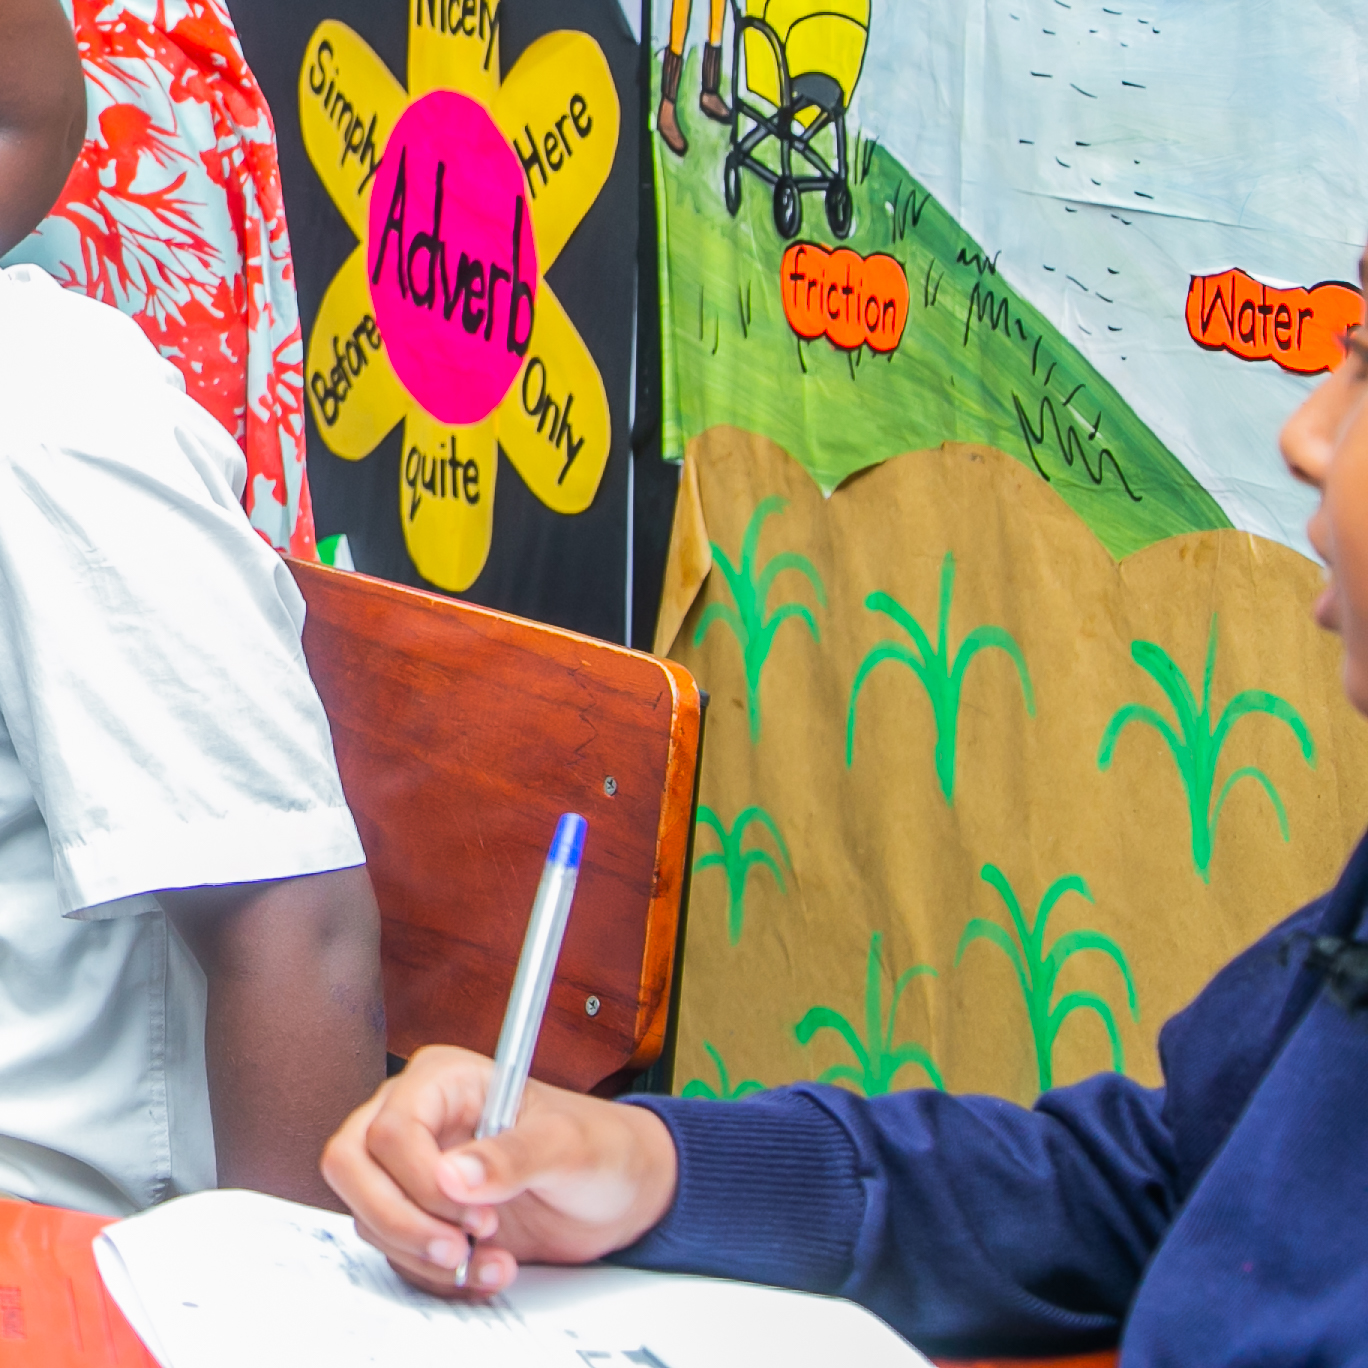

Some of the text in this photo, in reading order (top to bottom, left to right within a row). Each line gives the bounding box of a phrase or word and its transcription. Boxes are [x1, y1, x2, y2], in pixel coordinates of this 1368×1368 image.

[308, 39, 385, 196] Simply
[514, 92, 593, 201] Here
[371, 145, 536, 359] Adverb
[789, 246, 898, 337] friction
[1200, 274, 1315, 352] Water
[309, 312, 383, 426] Before
[521, 355, 586, 486] Only
[404, 434, 480, 521] quite
